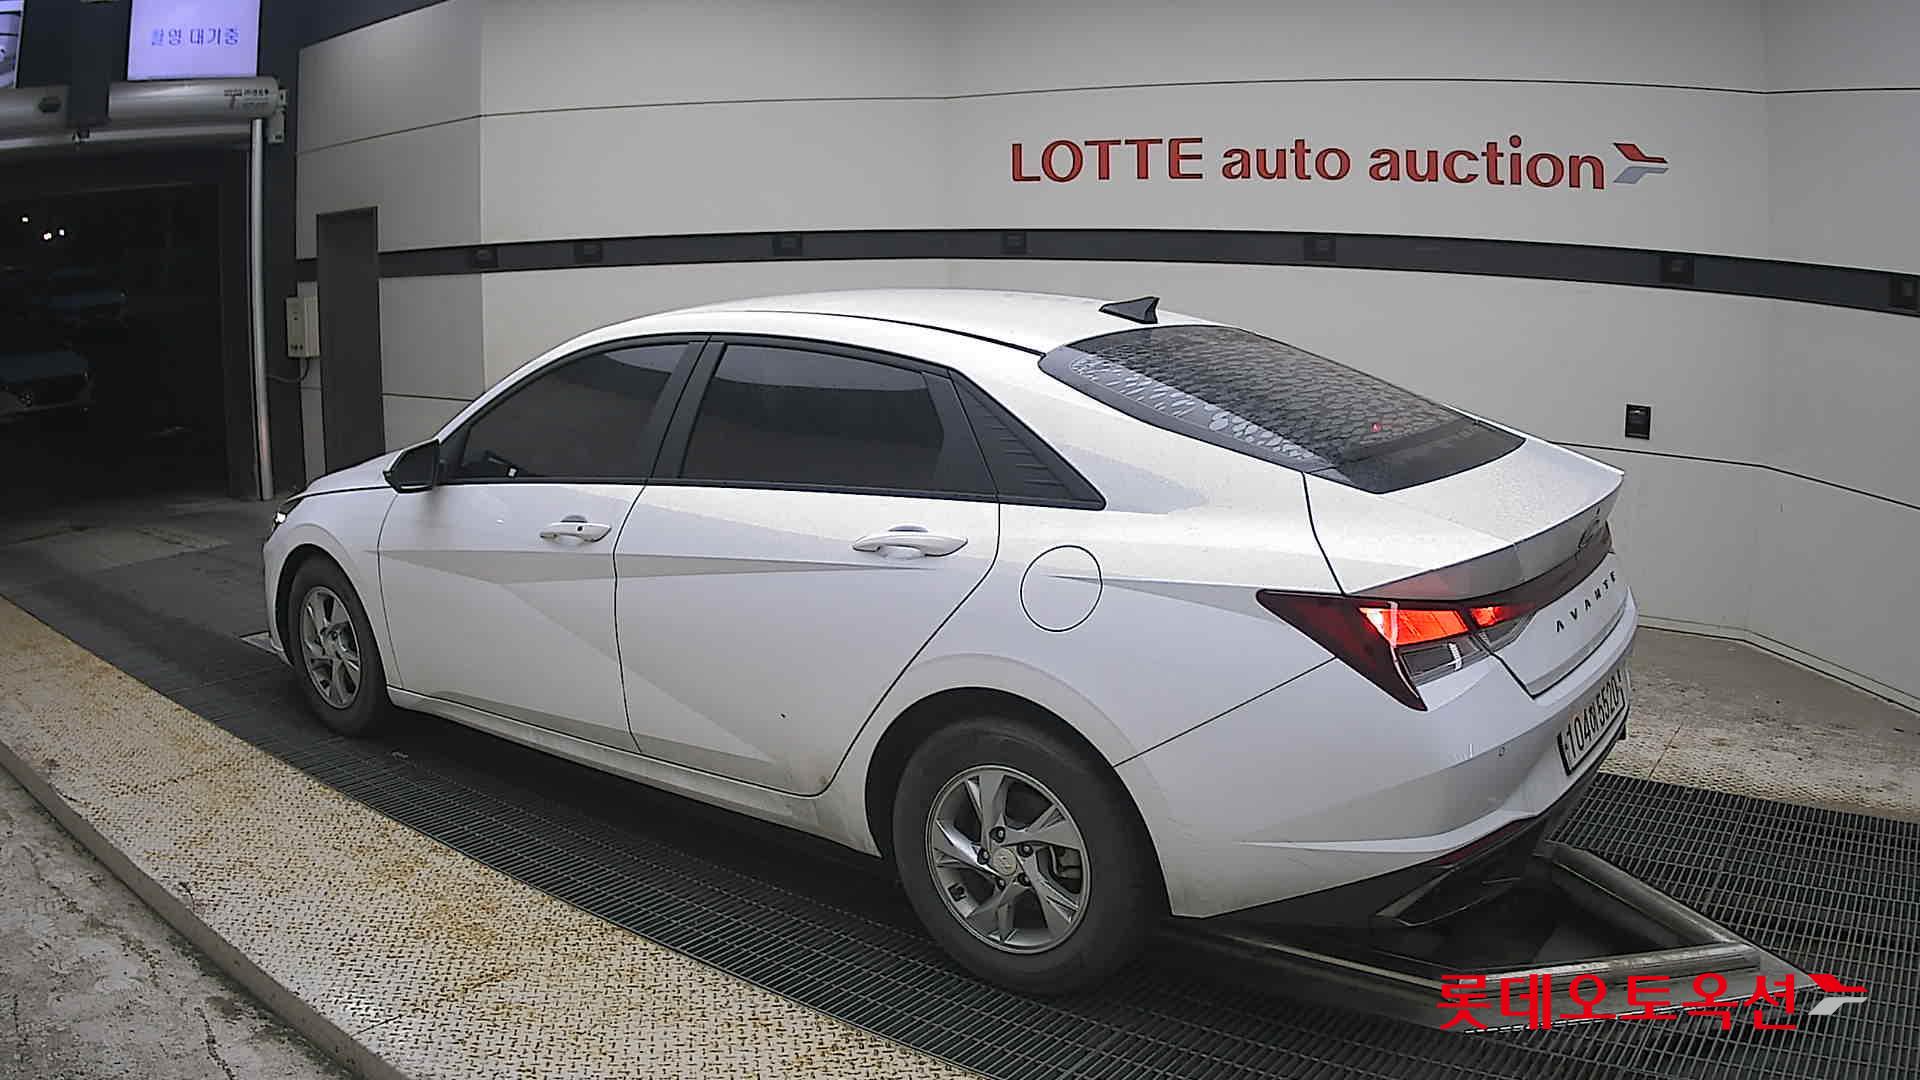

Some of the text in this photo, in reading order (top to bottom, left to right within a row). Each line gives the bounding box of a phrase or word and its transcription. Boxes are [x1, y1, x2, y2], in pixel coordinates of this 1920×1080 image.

[1011, 134, 1606, 191] LOTTE auto auction
[1555, 570, 1617, 633] AVANTE
